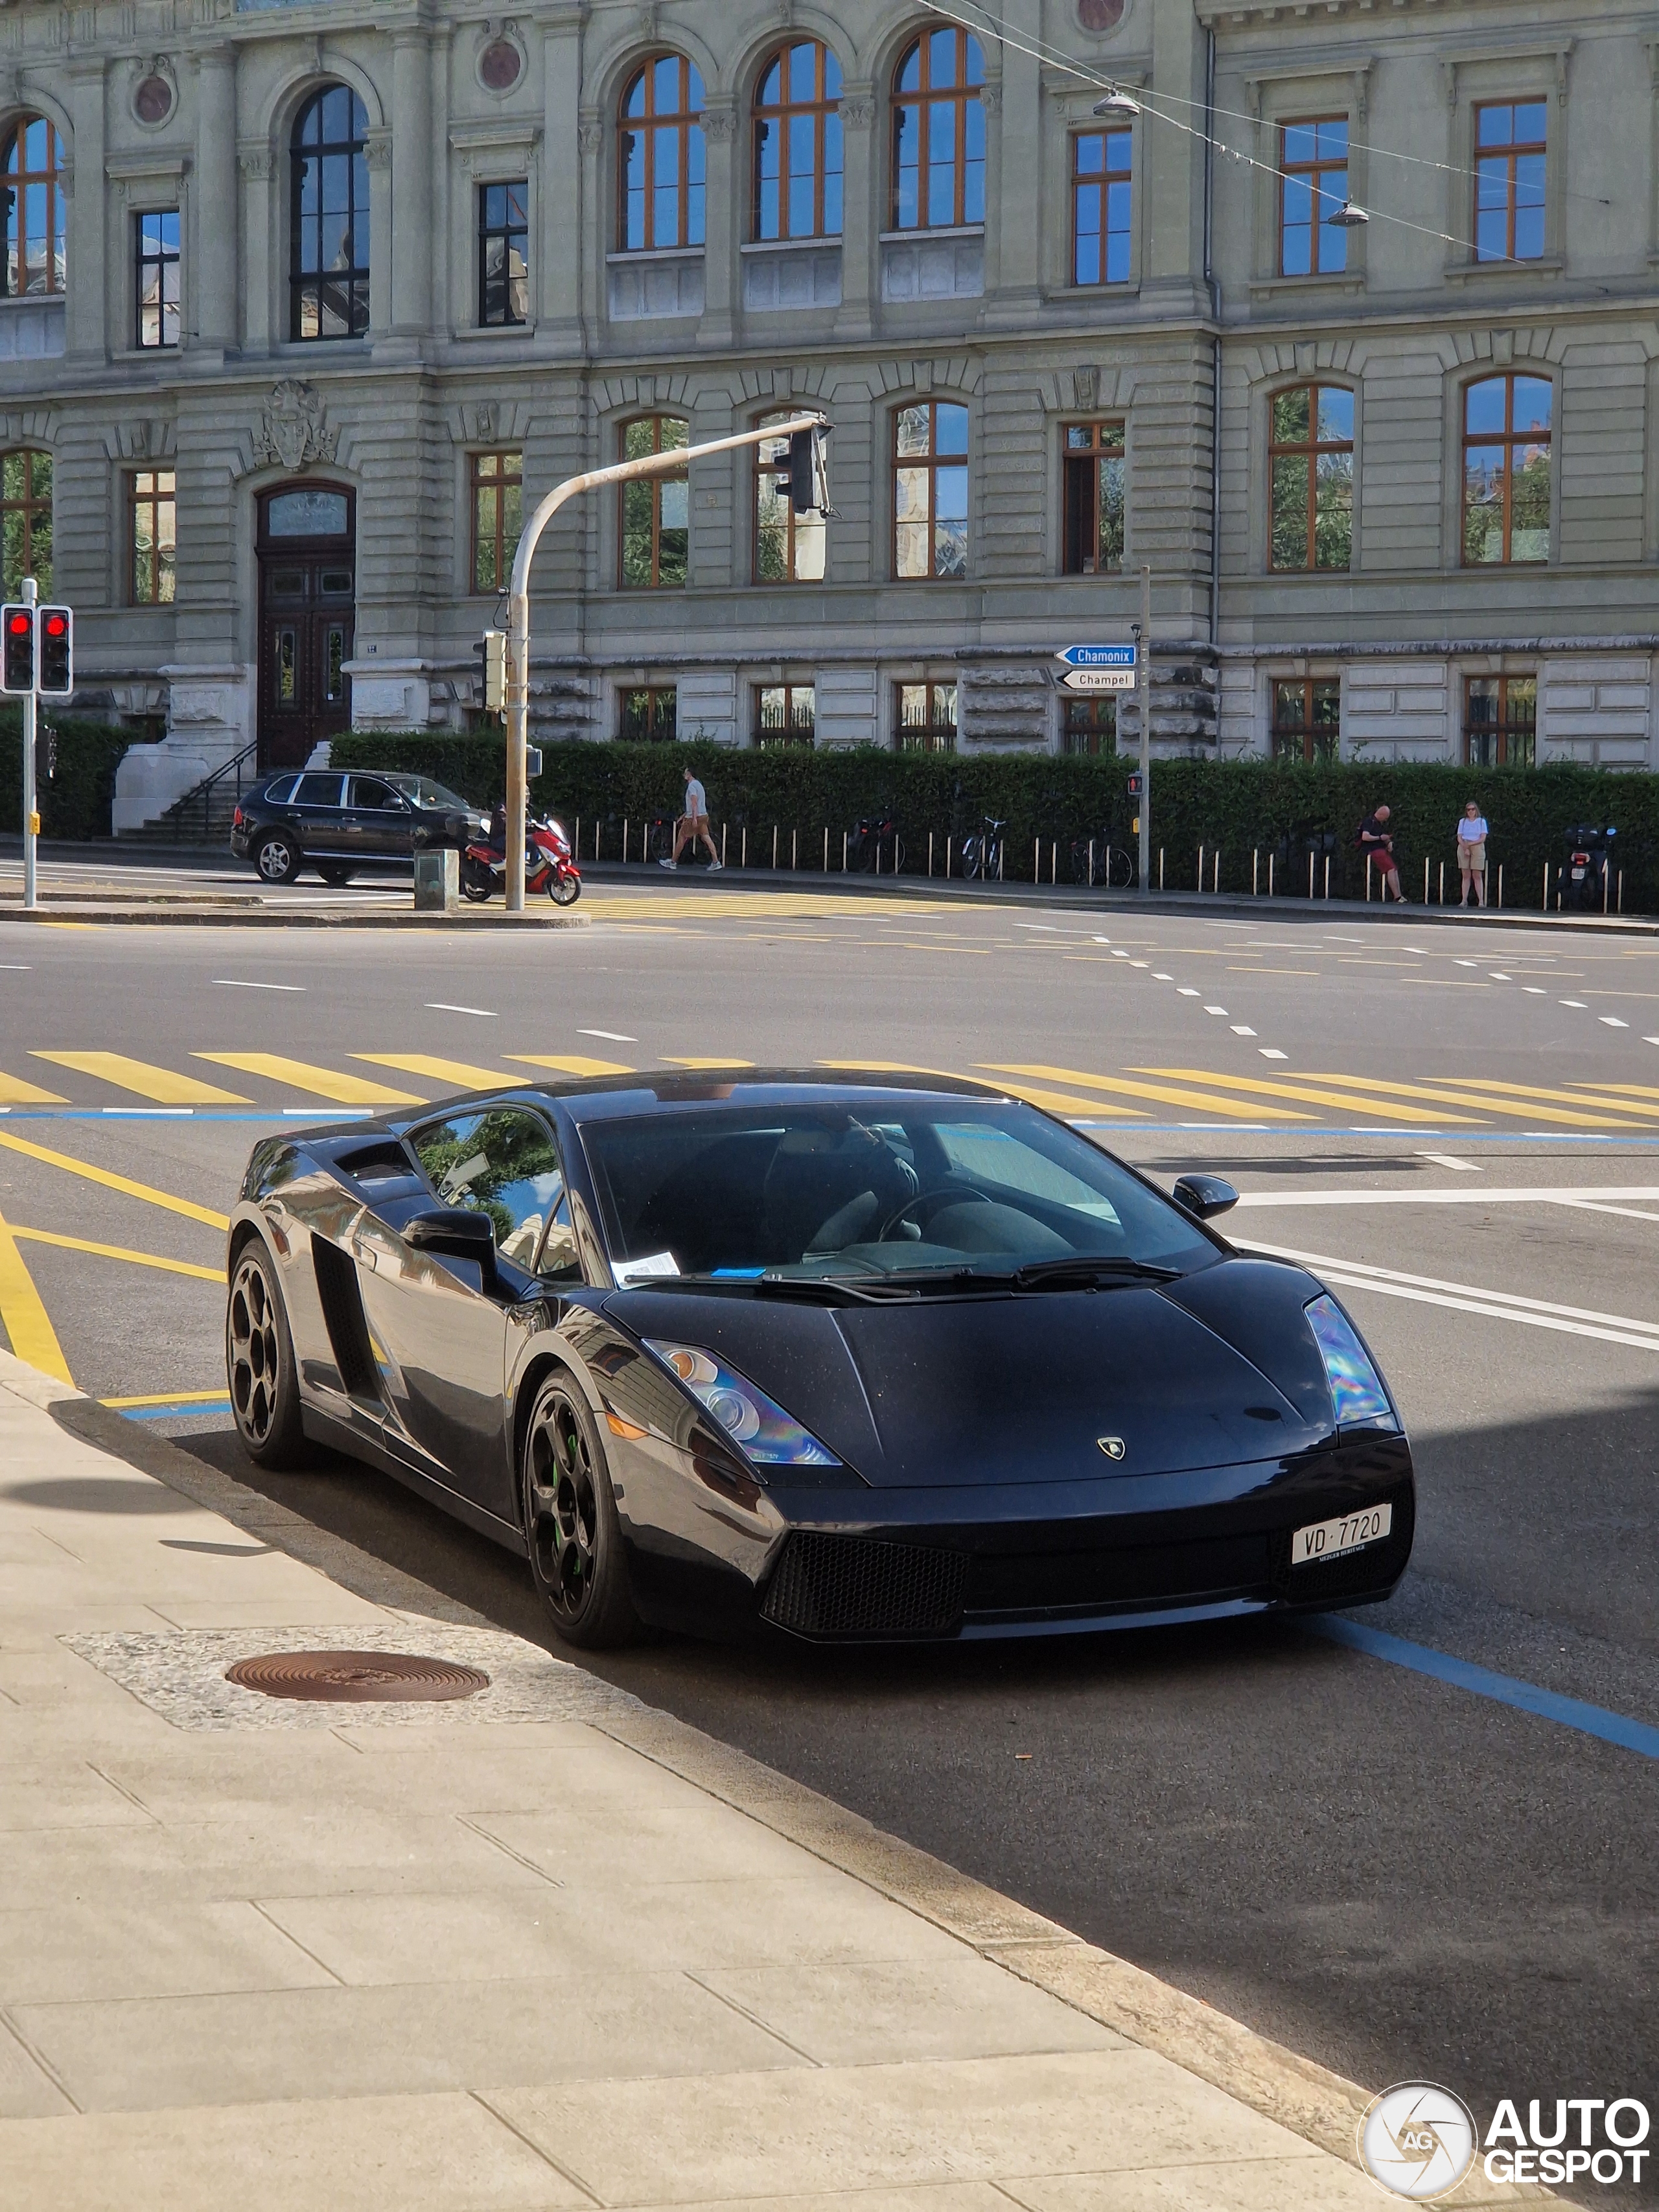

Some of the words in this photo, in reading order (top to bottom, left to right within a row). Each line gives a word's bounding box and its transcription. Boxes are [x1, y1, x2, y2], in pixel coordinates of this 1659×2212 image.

[1078, 649, 1130, 662] Chamonix
[1080, 675, 1128, 686] Champel
[1305, 1530, 1326, 1555] VD
[1339, 1512, 1380, 1546] 7720
[1340, 1544, 1365, 1557] HERITAGE
